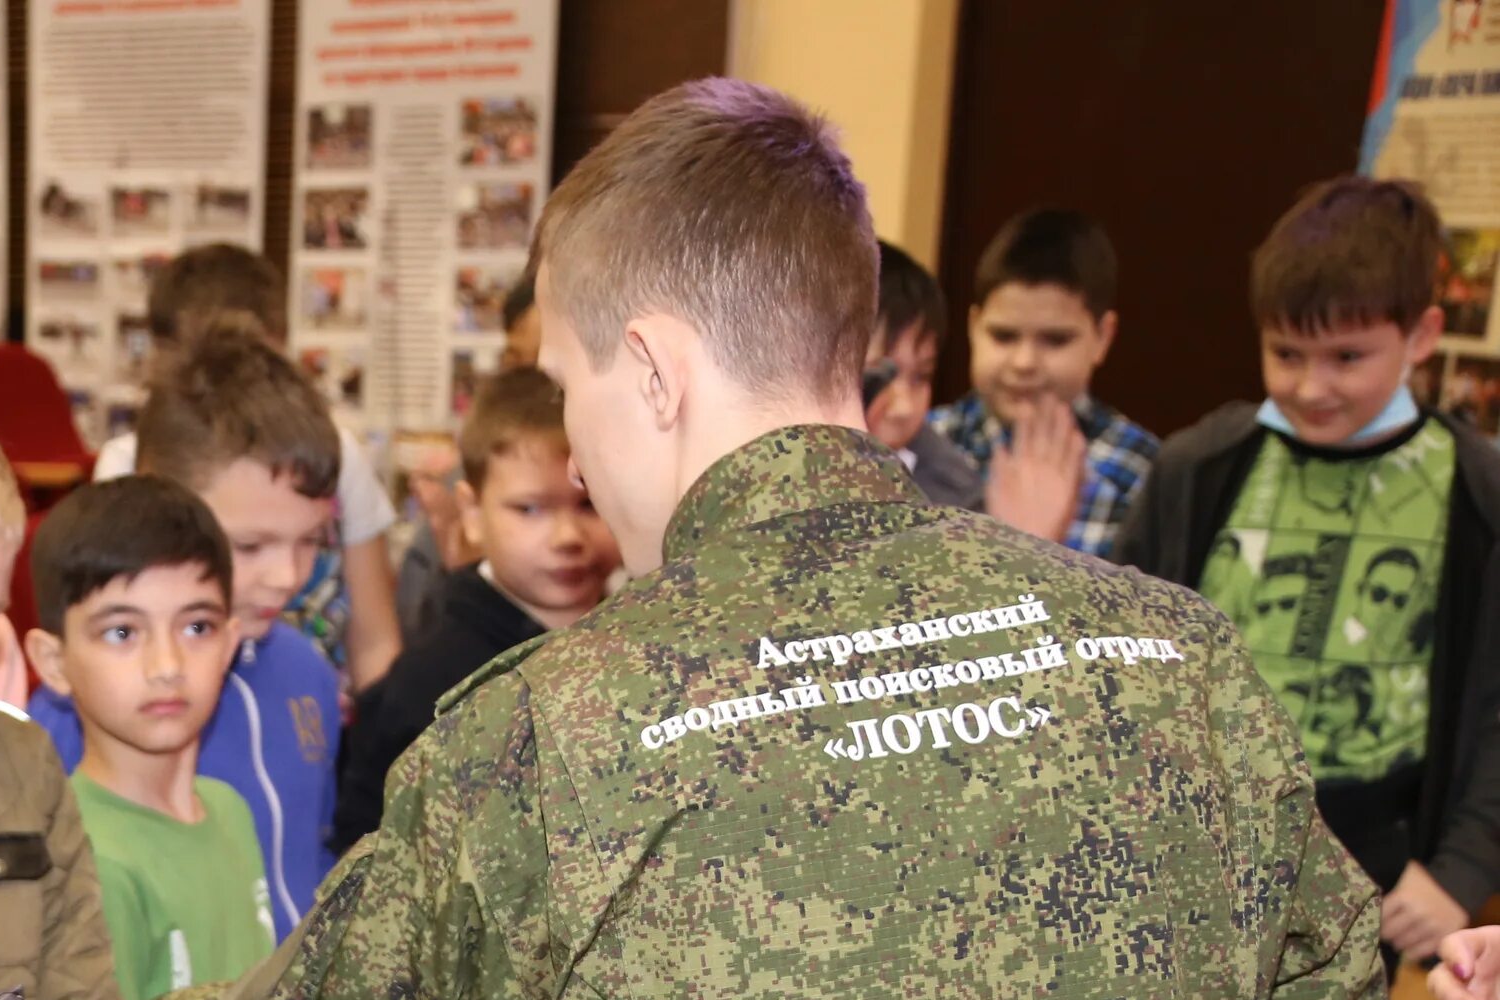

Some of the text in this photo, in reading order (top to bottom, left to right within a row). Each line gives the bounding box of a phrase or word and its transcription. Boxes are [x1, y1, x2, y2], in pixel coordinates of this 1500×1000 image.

[756, 593, 1051, 669] Астраханский
[640, 635, 1184, 749] сводный поисковый отряд
[823, 695, 1051, 761] «ЛОТОС»
